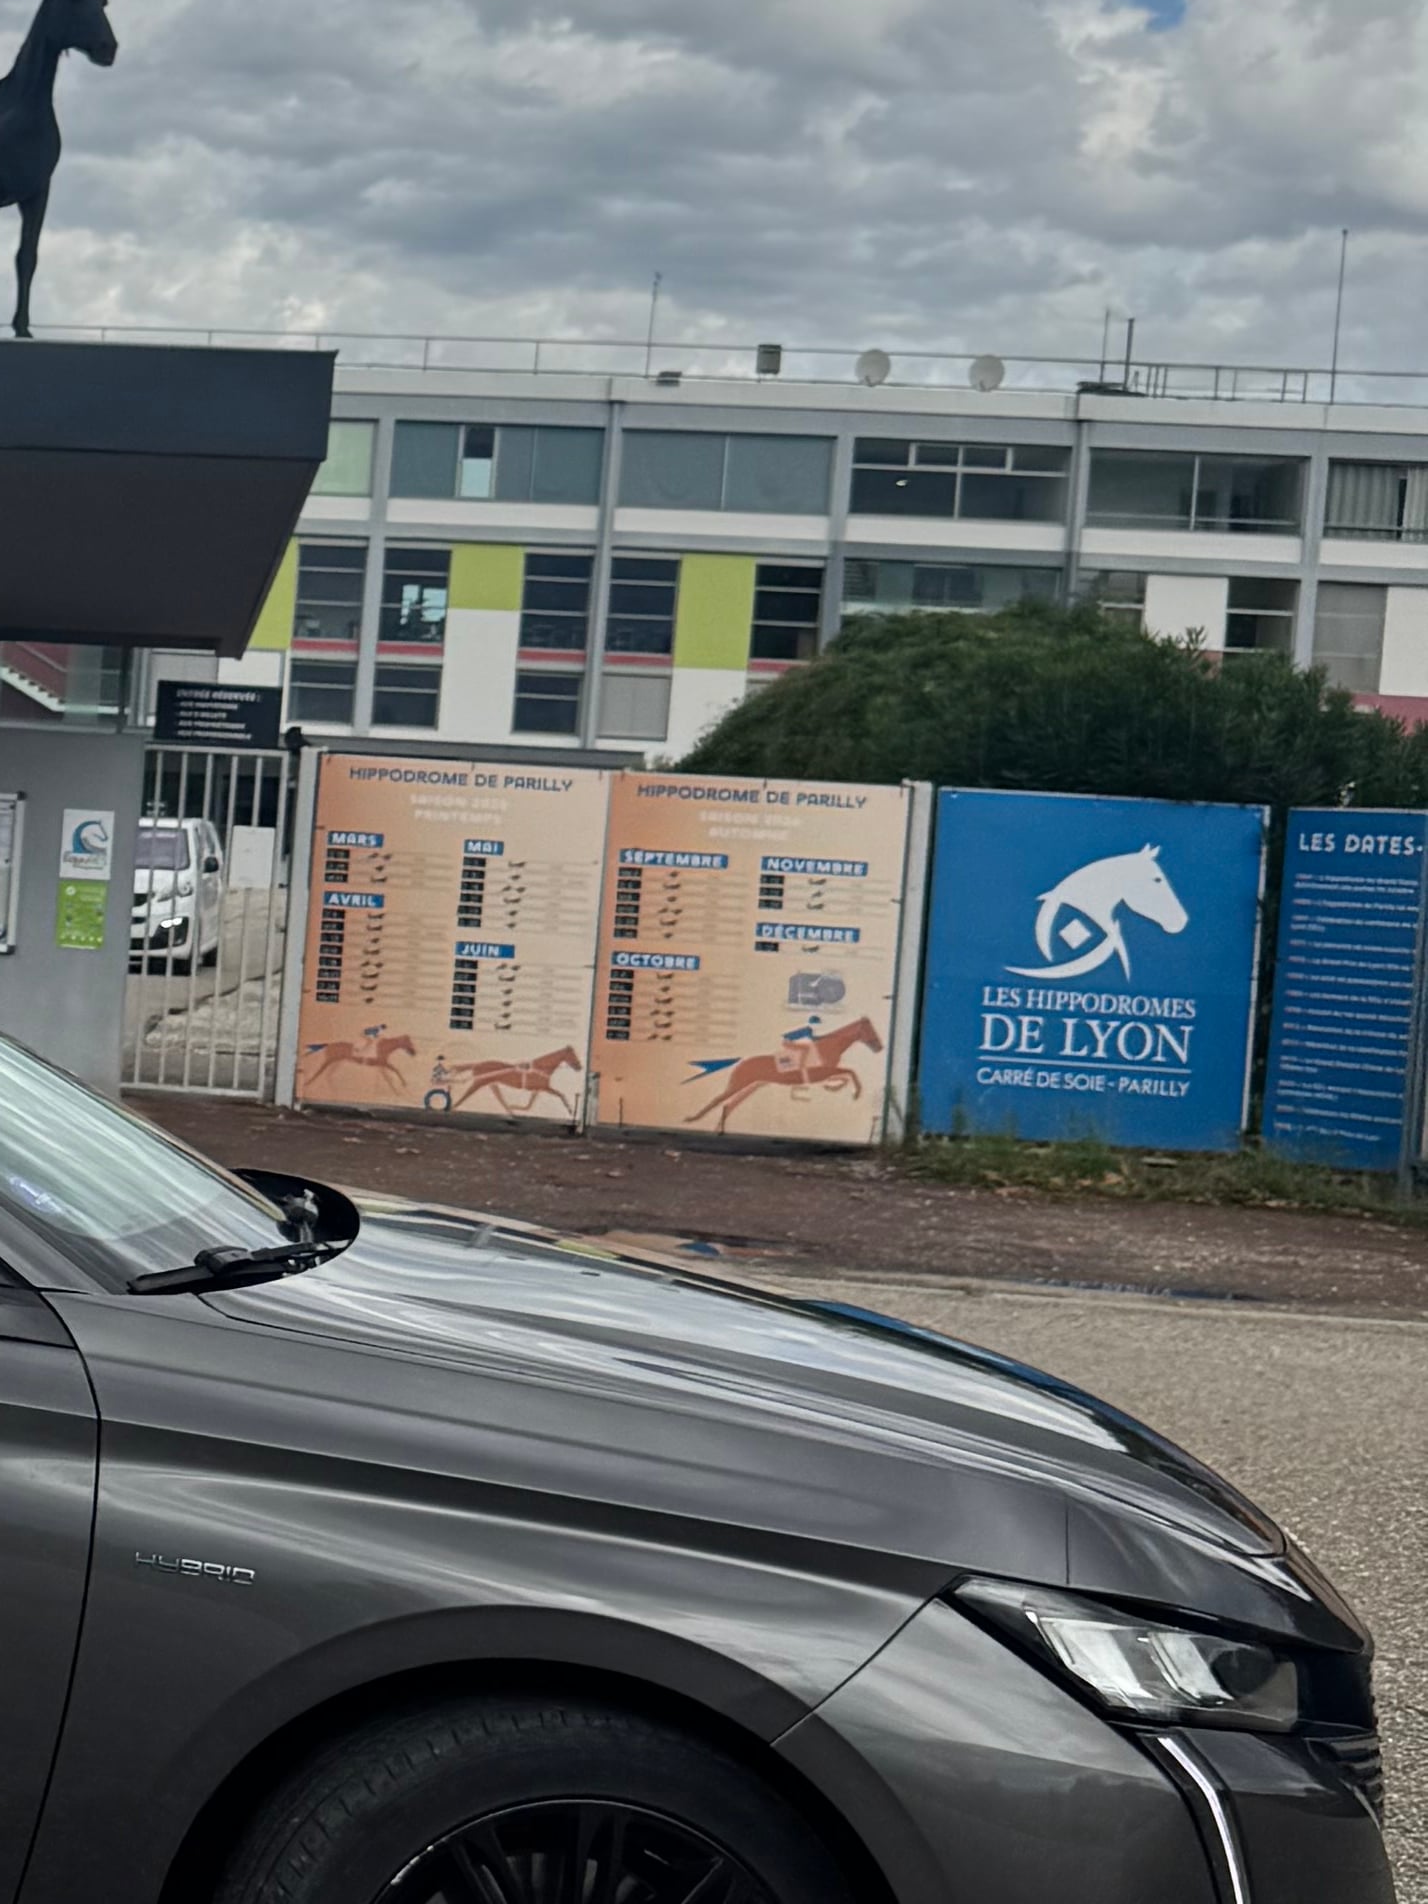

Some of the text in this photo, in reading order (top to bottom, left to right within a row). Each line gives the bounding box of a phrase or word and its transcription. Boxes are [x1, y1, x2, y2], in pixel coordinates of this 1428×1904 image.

[349, 767, 573, 792] HIPPODROME DE PARILLY
[637, 784, 867, 809] HIPPODROME DE PARILLY
[331, 832, 378, 846] MARS
[467, 841, 498, 853] MAI
[1299, 832, 1335, 853] LES
[624, 849, 723, 867] SEPTEMBRE
[767, 858, 864, 875] NOVEMBRE
[328, 892, 376, 906] AVRIL
[461, 943, 500, 957] JUIN
[616, 952, 696, 969] OCTOBRE
[982, 985, 1196, 1019] LES HIPPODROMES
[979, 1013, 1193, 1064] DE LYON
[976, 1067, 1033, 1087] CARRÉ
[1036, 1070, 1061, 1089] DE
[1064, 1073, 1105, 1093] SOIE
[1118, 1077, 1190, 1097] PARILLY
